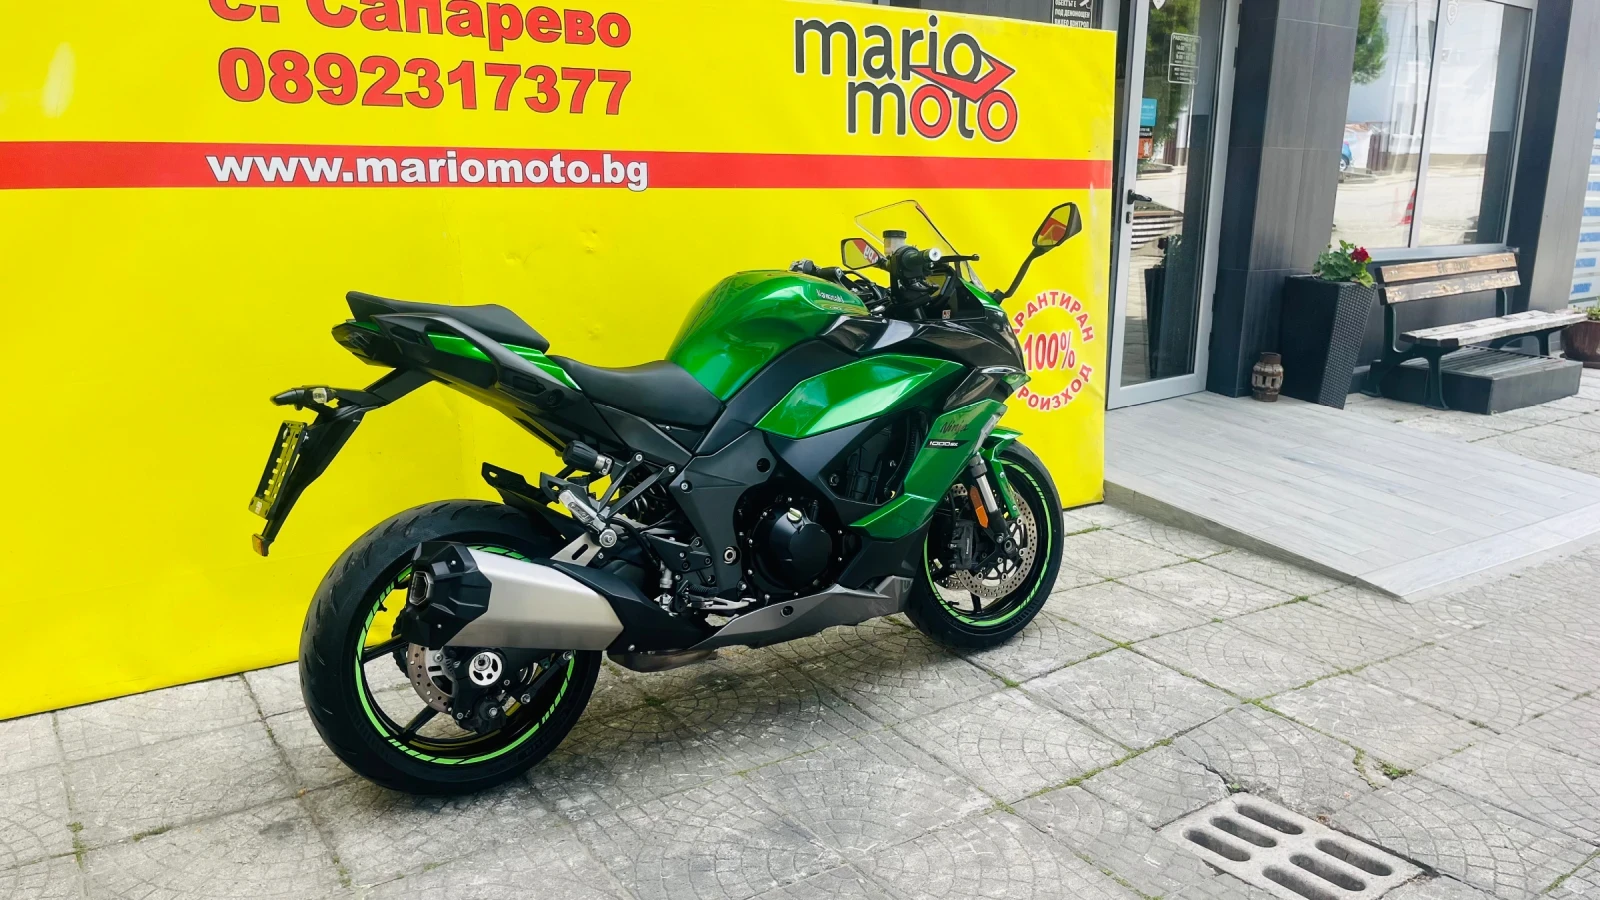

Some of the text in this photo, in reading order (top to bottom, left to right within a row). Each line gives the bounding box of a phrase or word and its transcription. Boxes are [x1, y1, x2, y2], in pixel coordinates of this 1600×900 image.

[305, 0, 632, 52] Сапарево
[794, 14, 983, 81] mario
[217, 47, 632, 116] 0892317377
[847, 81, 1018, 142] moto
[205, 150, 649, 192] www.mariomoto.bg
[1013, 291, 1094, 342] РАНТИРАН
[1023, 331, 1076, 371] 100%
[1017, 364, 1093, 411] РОИЗХОД
